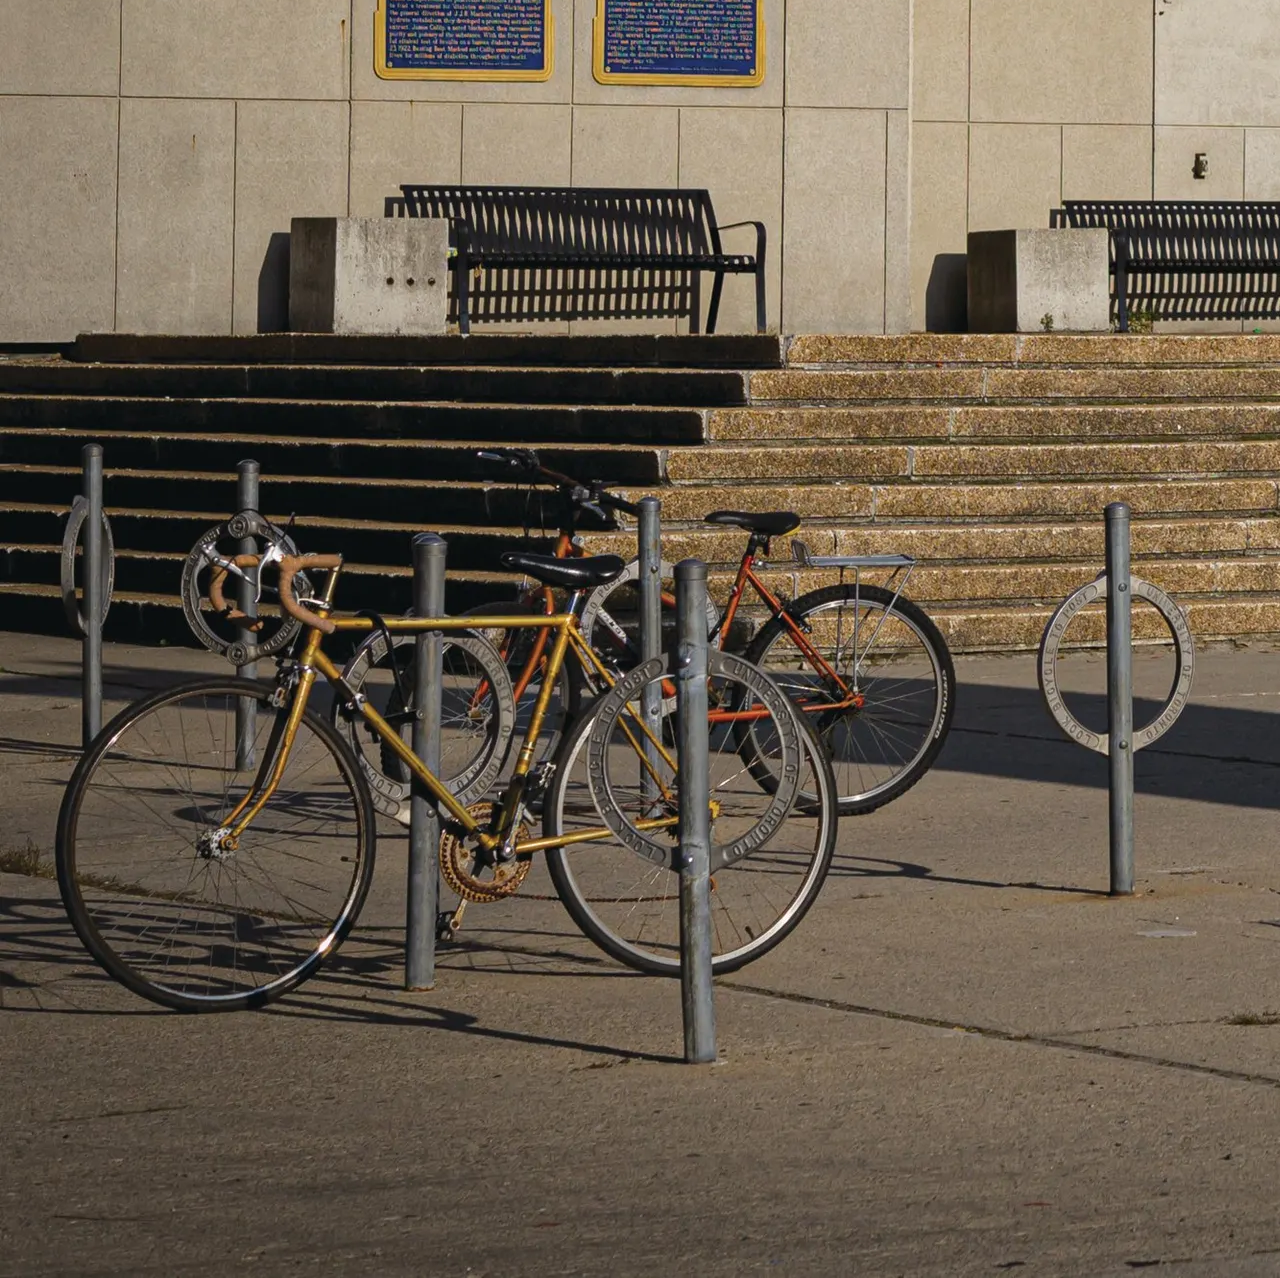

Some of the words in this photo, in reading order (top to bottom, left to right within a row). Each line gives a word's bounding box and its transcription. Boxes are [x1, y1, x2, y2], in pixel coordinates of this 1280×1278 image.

[1051, 624, 1063, 638] TO
[1064, 591, 1088, 619] POST
[1146, 588, 1192, 656] UNIVERSITY
[599, 706, 614, 727] TO
[614, 663, 652, 701] POST
[1181, 665, 1192, 682] OF
[733, 662, 799, 751] UNIVERSITY
[1146, 690, 1188, 738] TORONTO
[783, 764, 796, 783] OF
[732, 797, 789, 857] TORONTO
